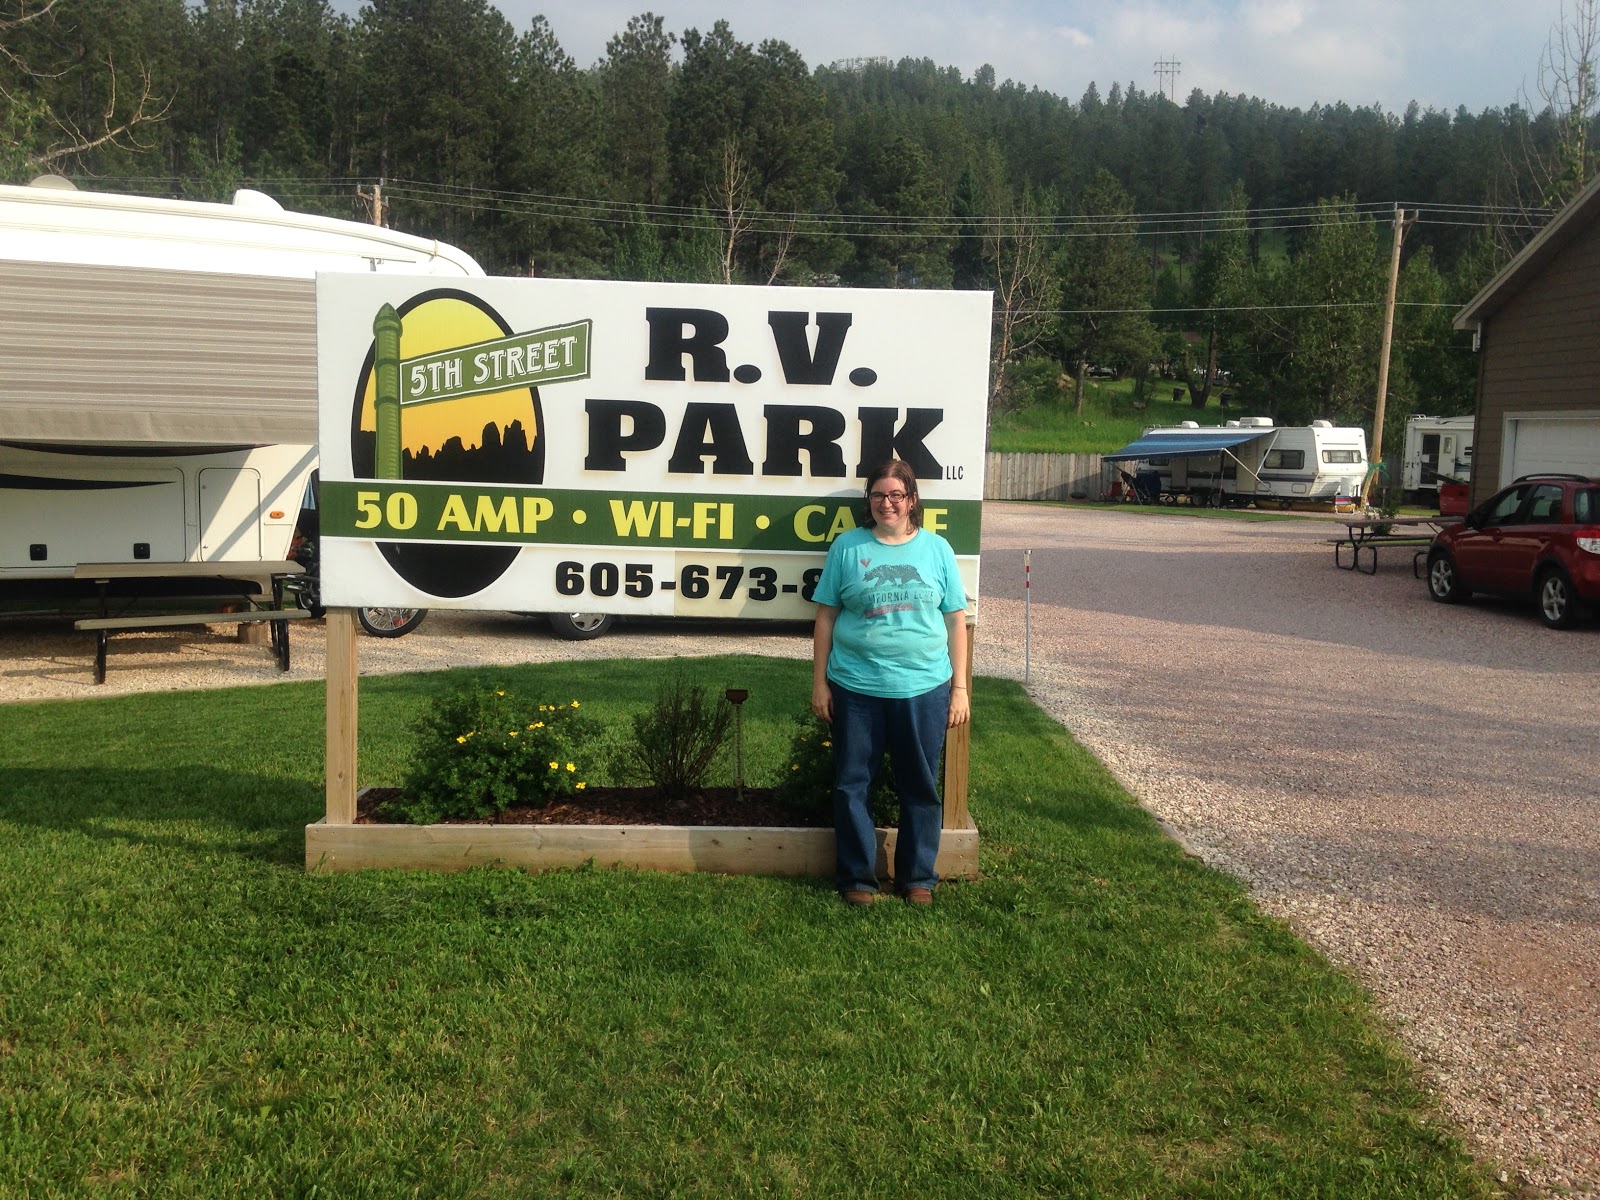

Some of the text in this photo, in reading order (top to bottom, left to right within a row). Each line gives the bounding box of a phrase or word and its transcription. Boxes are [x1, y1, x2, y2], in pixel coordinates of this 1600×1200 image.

[410, 336, 577, 396] 5TH STREET
[645, 307, 877, 387] R.V.
[584, 398, 964, 480] PARK LLC
[355, 491, 948, 543] 50 AMP WI-FI CAE
[555, 561, 824, 603] 605-673-8
